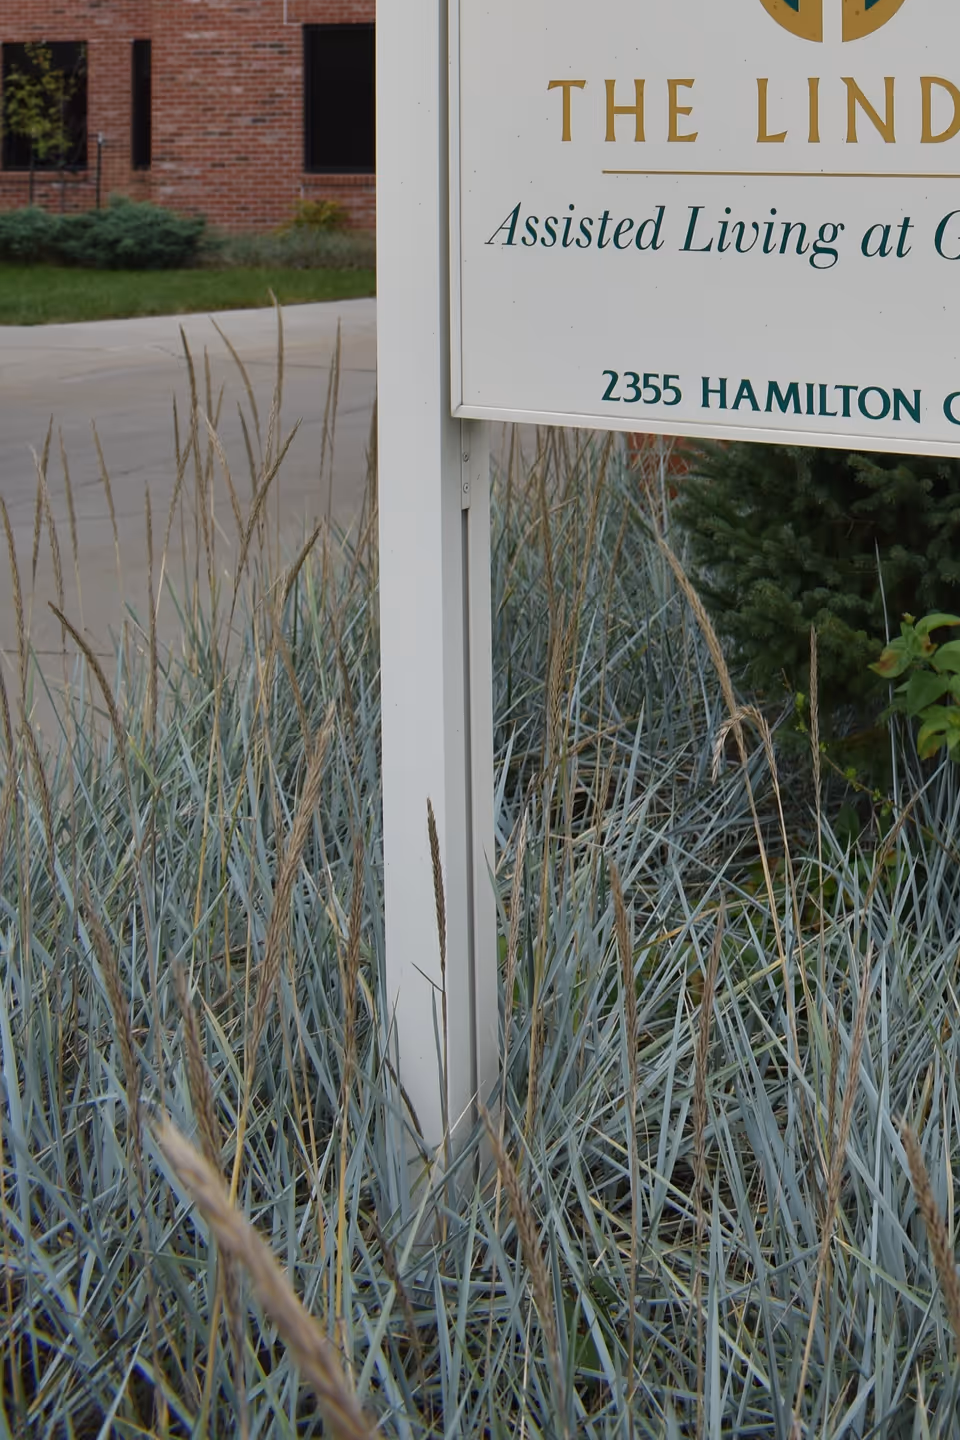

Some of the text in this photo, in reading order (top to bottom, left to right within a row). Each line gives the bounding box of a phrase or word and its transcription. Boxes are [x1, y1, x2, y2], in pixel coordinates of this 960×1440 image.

[547, 77, 699, 143] THE
[484, 201, 666, 251] Assisted
[679, 206, 845, 269] Living
[860, 216, 915, 258] at
[601, 370, 682, 407] 2355
[701, 376, 922, 424] HAMILTON
